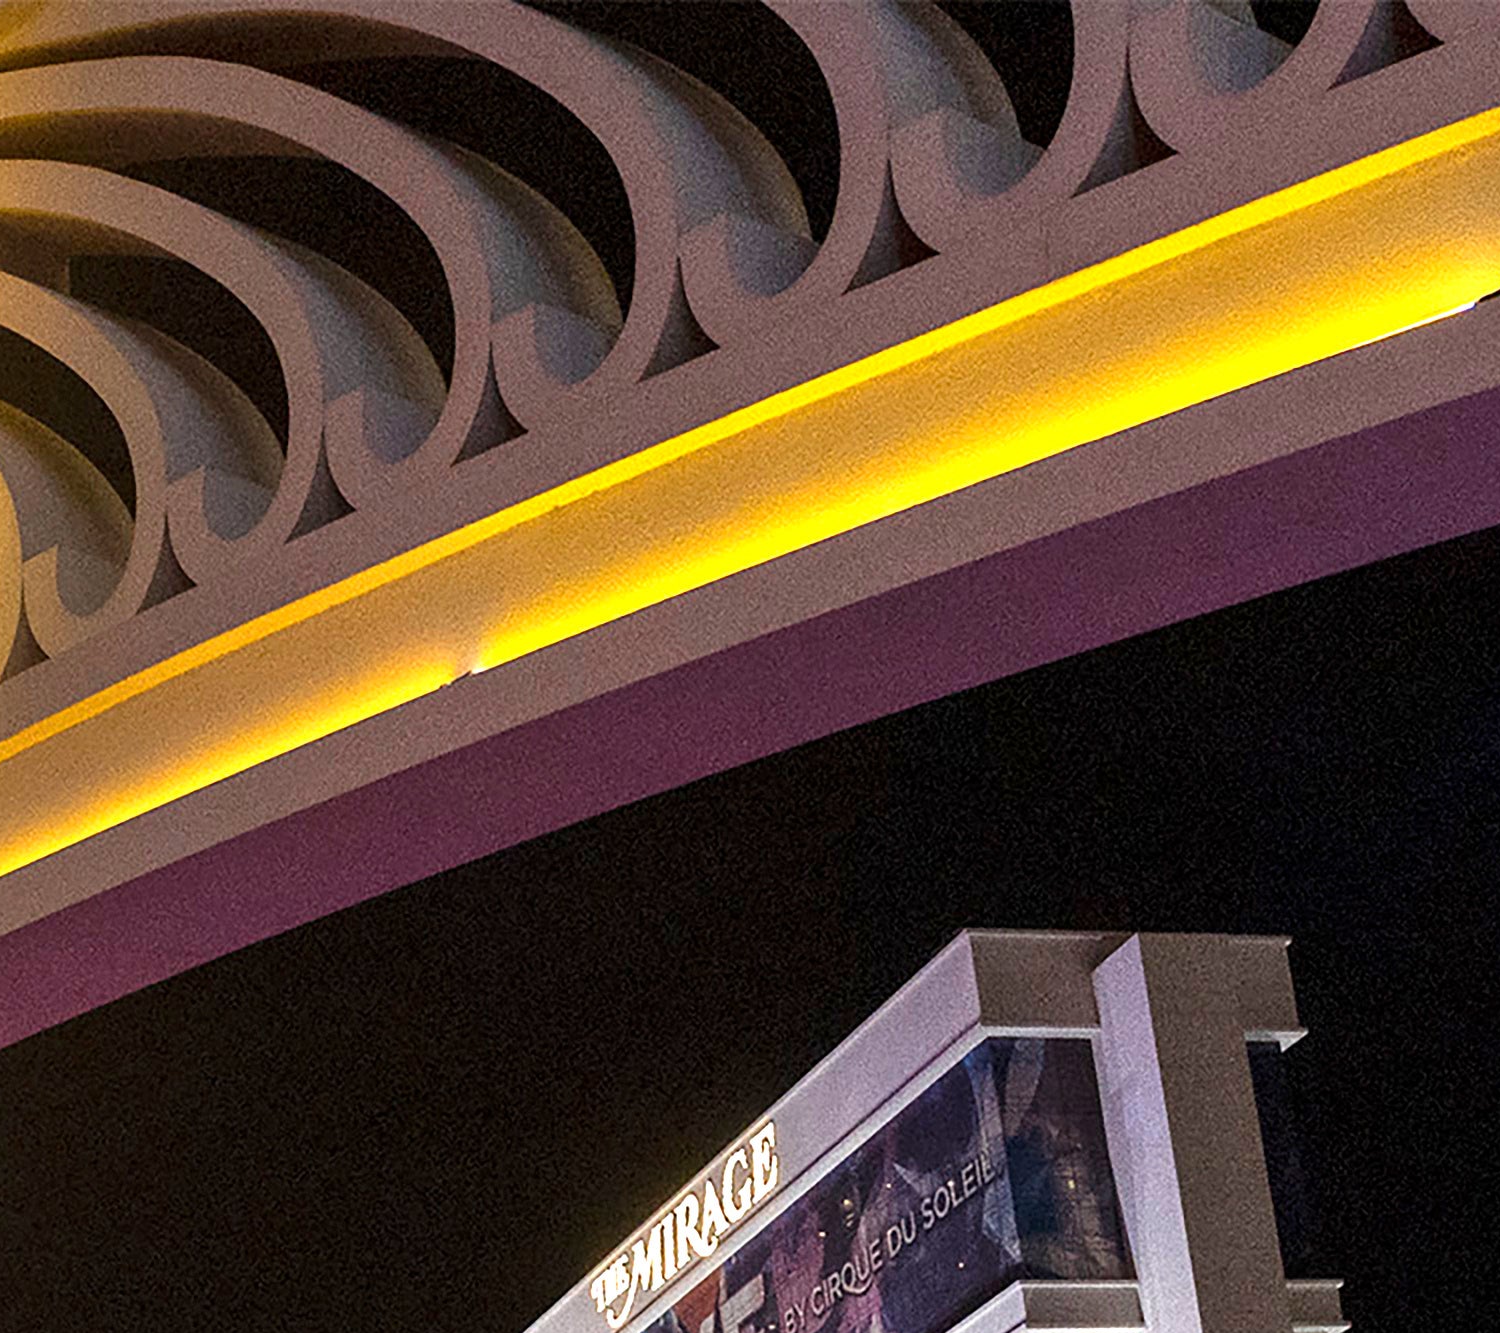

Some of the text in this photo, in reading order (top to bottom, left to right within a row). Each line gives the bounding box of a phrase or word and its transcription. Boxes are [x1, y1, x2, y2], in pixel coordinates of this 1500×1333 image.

[591, 1120, 778, 1329] THE MIRAGE
[809, 1238, 886, 1318] CIRQUE
[886, 1211, 917, 1258] DU
[920, 1156, 996, 1230] SOLEIL
